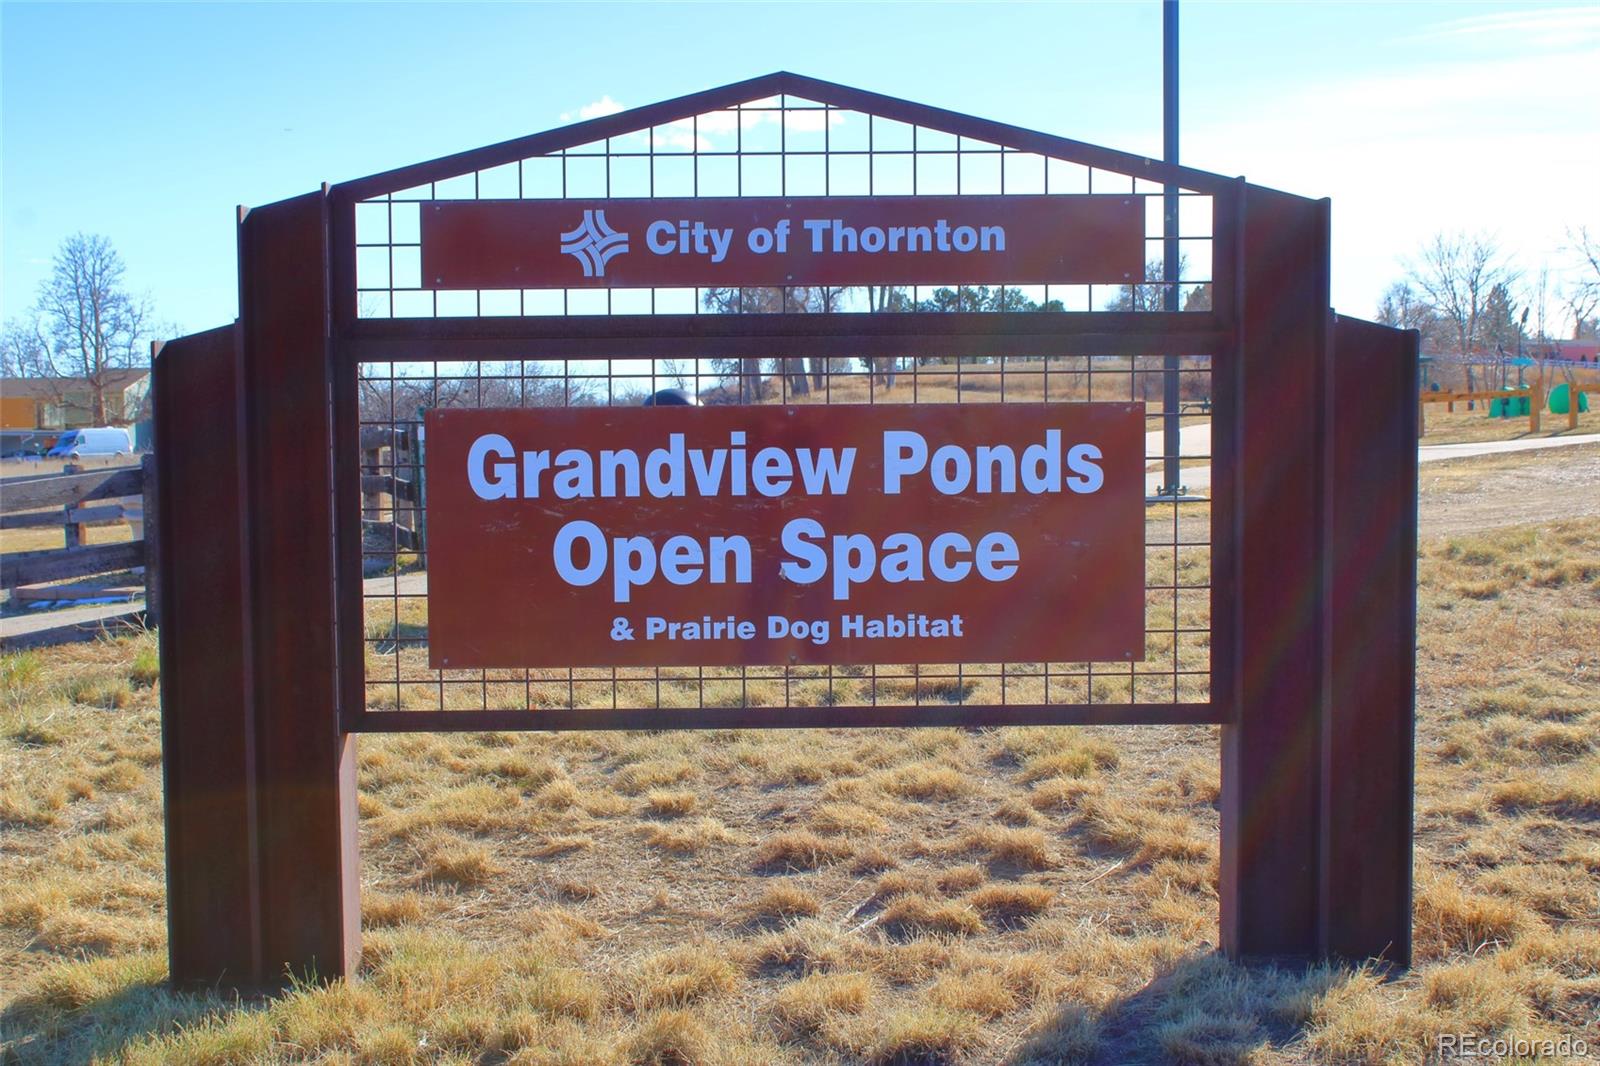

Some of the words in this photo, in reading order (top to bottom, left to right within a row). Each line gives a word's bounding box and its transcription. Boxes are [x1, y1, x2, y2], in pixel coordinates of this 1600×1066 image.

[645, 219, 734, 263] City
[747, 218, 790, 254] of
[802, 218, 1006, 253] Thornton
[467, 431, 857, 501] Grandview
[883, 429, 1104, 496] Ponds
[553, 520, 752, 603] Open
[779, 518, 1020, 601] Space
[610, 617, 635, 641] &
[645, 615, 756, 641] Prairie
[767, 615, 830, 645] Dog
[841, 613, 964, 639] Habitat
